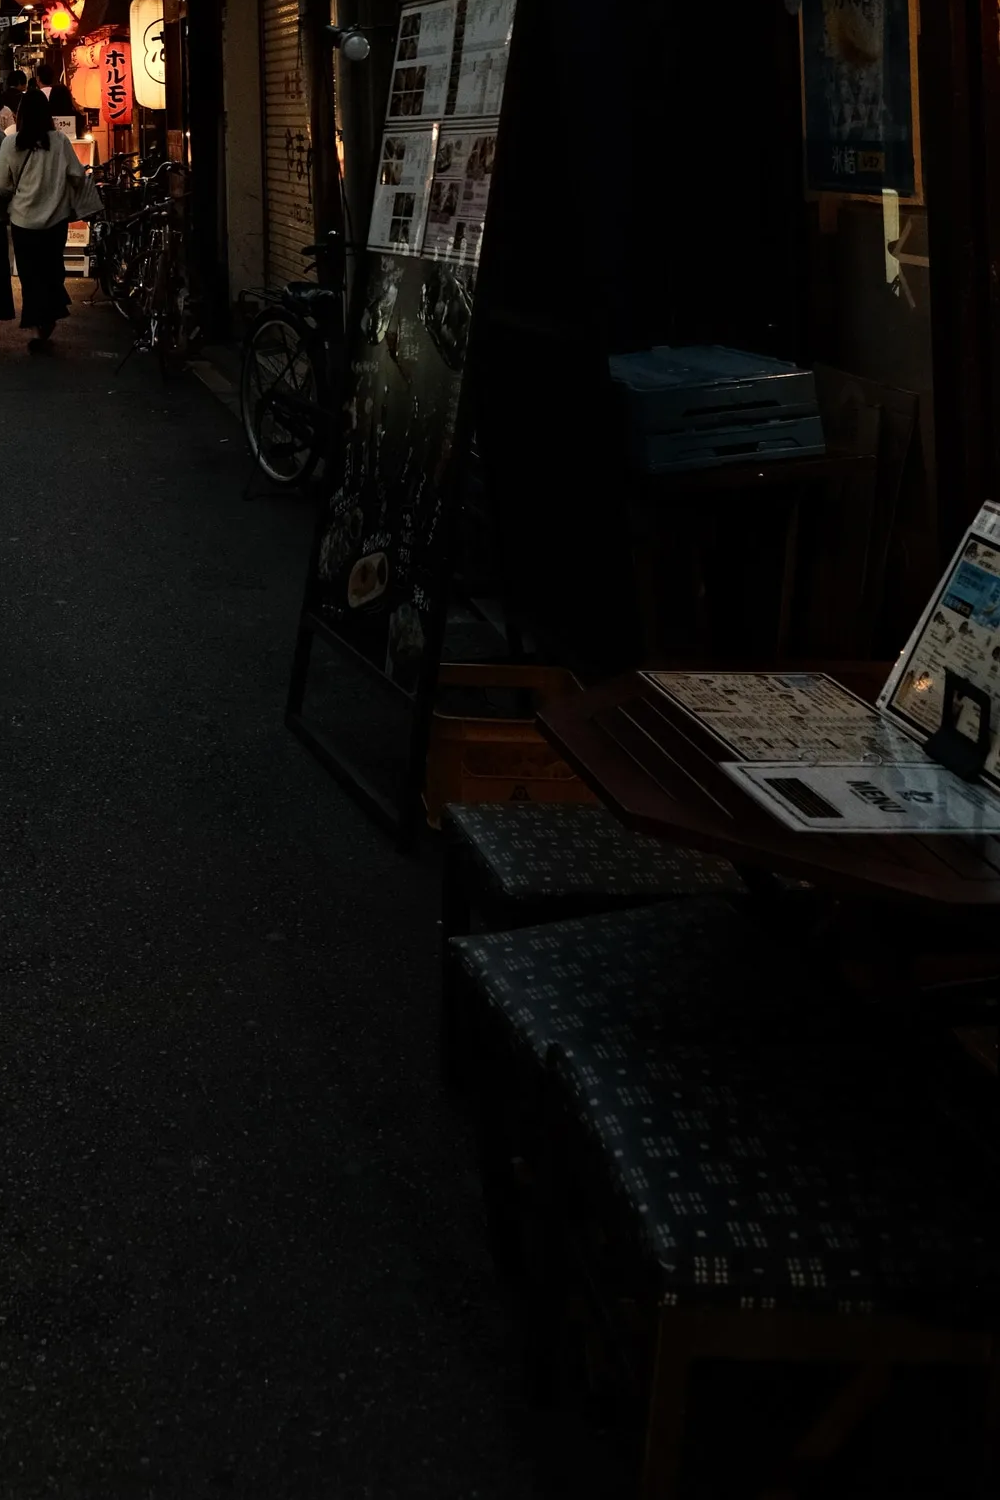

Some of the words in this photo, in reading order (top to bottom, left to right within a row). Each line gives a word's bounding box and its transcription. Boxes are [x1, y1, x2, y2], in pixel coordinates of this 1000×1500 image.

[105, 49, 128, 120] ホルモン
[846, 779, 907, 814] MENU
